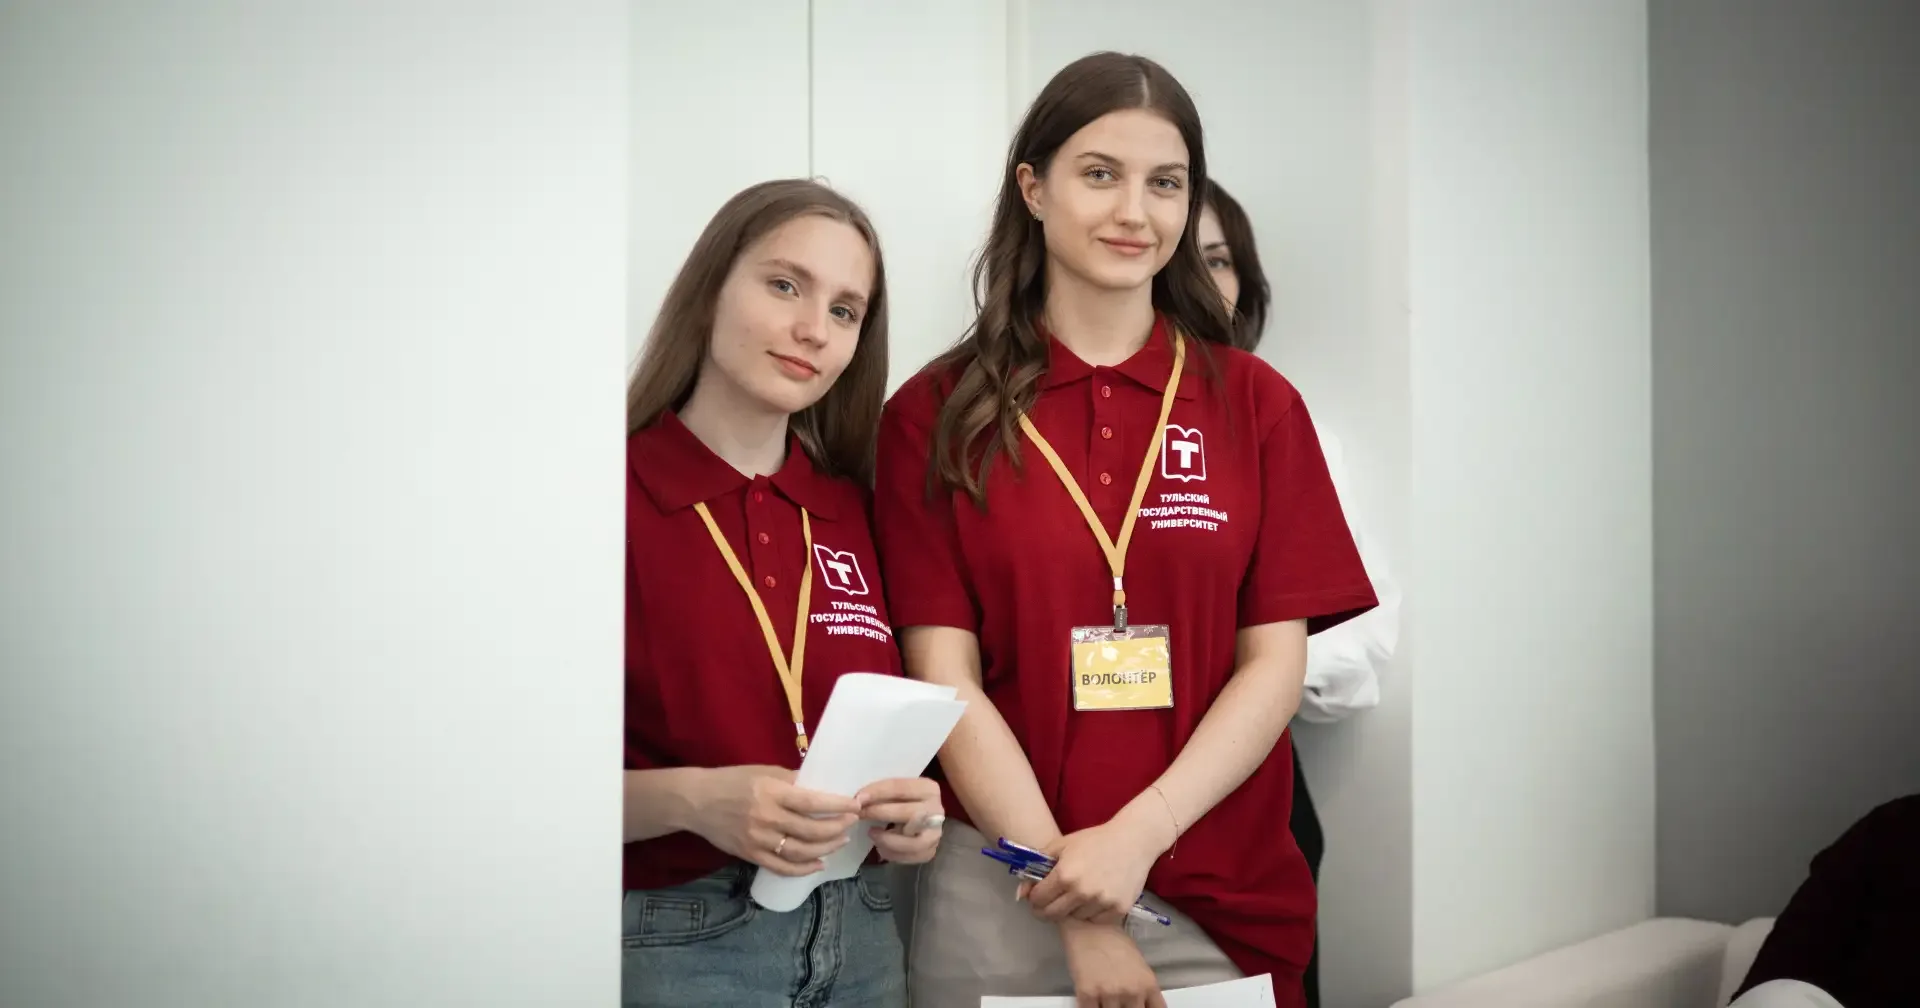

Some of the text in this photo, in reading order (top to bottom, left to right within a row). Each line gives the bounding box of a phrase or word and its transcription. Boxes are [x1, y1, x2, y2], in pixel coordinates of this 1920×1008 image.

[1160, 492, 1210, 504] ТУЛЬСКИЙ
[1138, 505, 1228, 522] ГОСУДАРСТВЕННЫЙ
[1150, 518, 1218, 531] УНИВЕРСИТЕТ
[831, 601, 877, 615] ТУЛЬСКИЙ
[810, 613, 892, 636] ГОСУДАРСТВЕННЫЙ
[826, 625, 887, 643] УНИВЕРСИТЕТ
